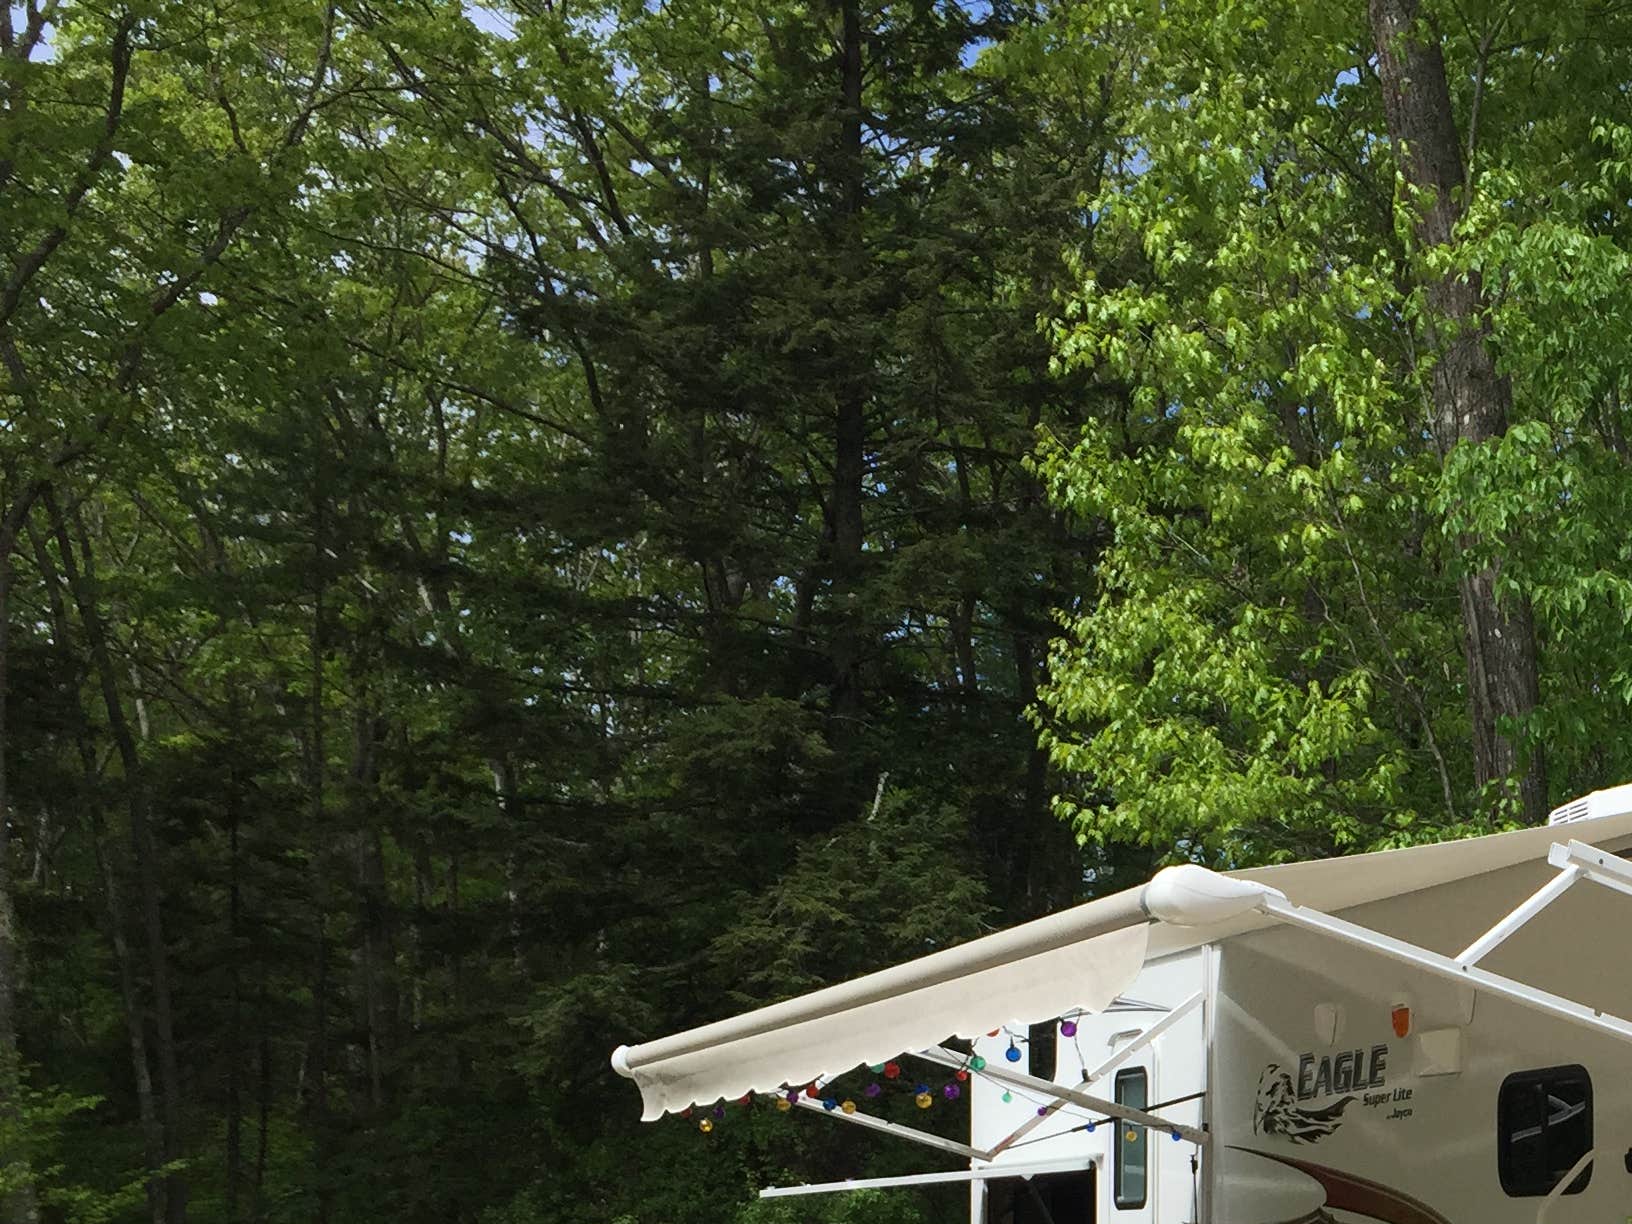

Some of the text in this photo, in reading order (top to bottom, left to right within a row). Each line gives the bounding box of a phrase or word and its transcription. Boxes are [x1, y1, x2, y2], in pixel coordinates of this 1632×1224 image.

[1297, 1044, 1388, 1101] EAGLE
[1363, 1088, 1413, 1108] Super Lite
